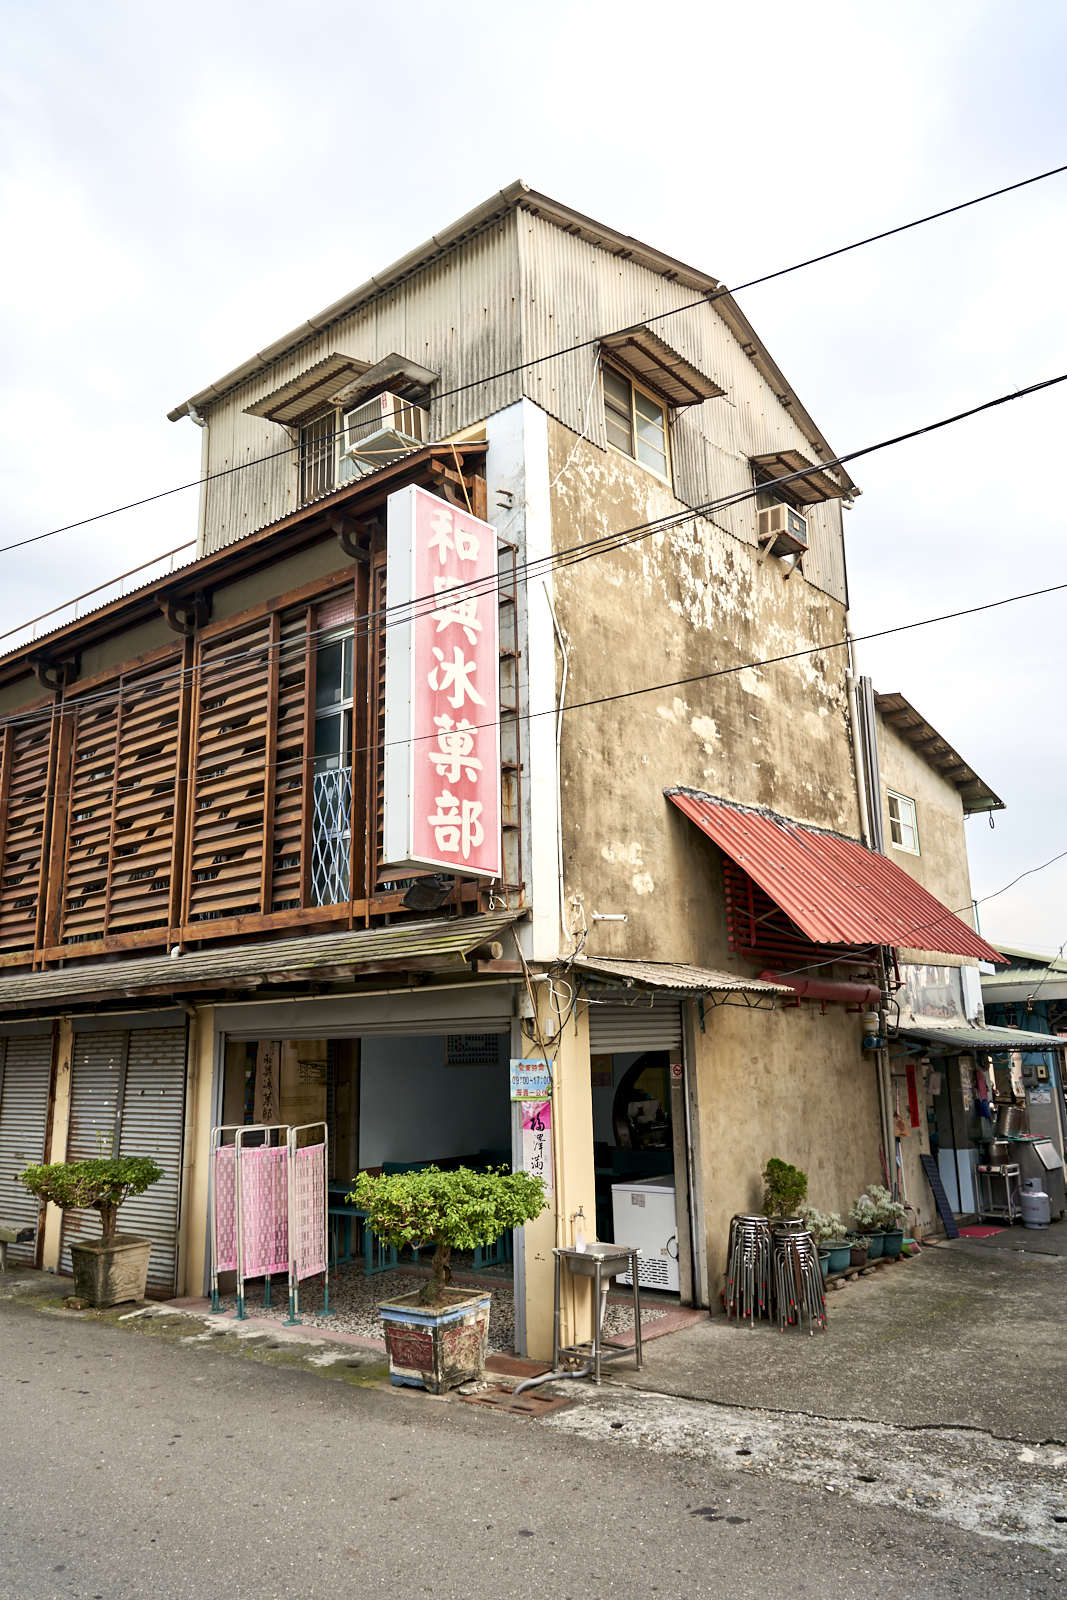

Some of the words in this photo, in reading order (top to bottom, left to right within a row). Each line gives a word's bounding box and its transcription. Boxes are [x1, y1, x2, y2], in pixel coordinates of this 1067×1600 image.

[428, 508, 486, 860] 和興冰菓部
